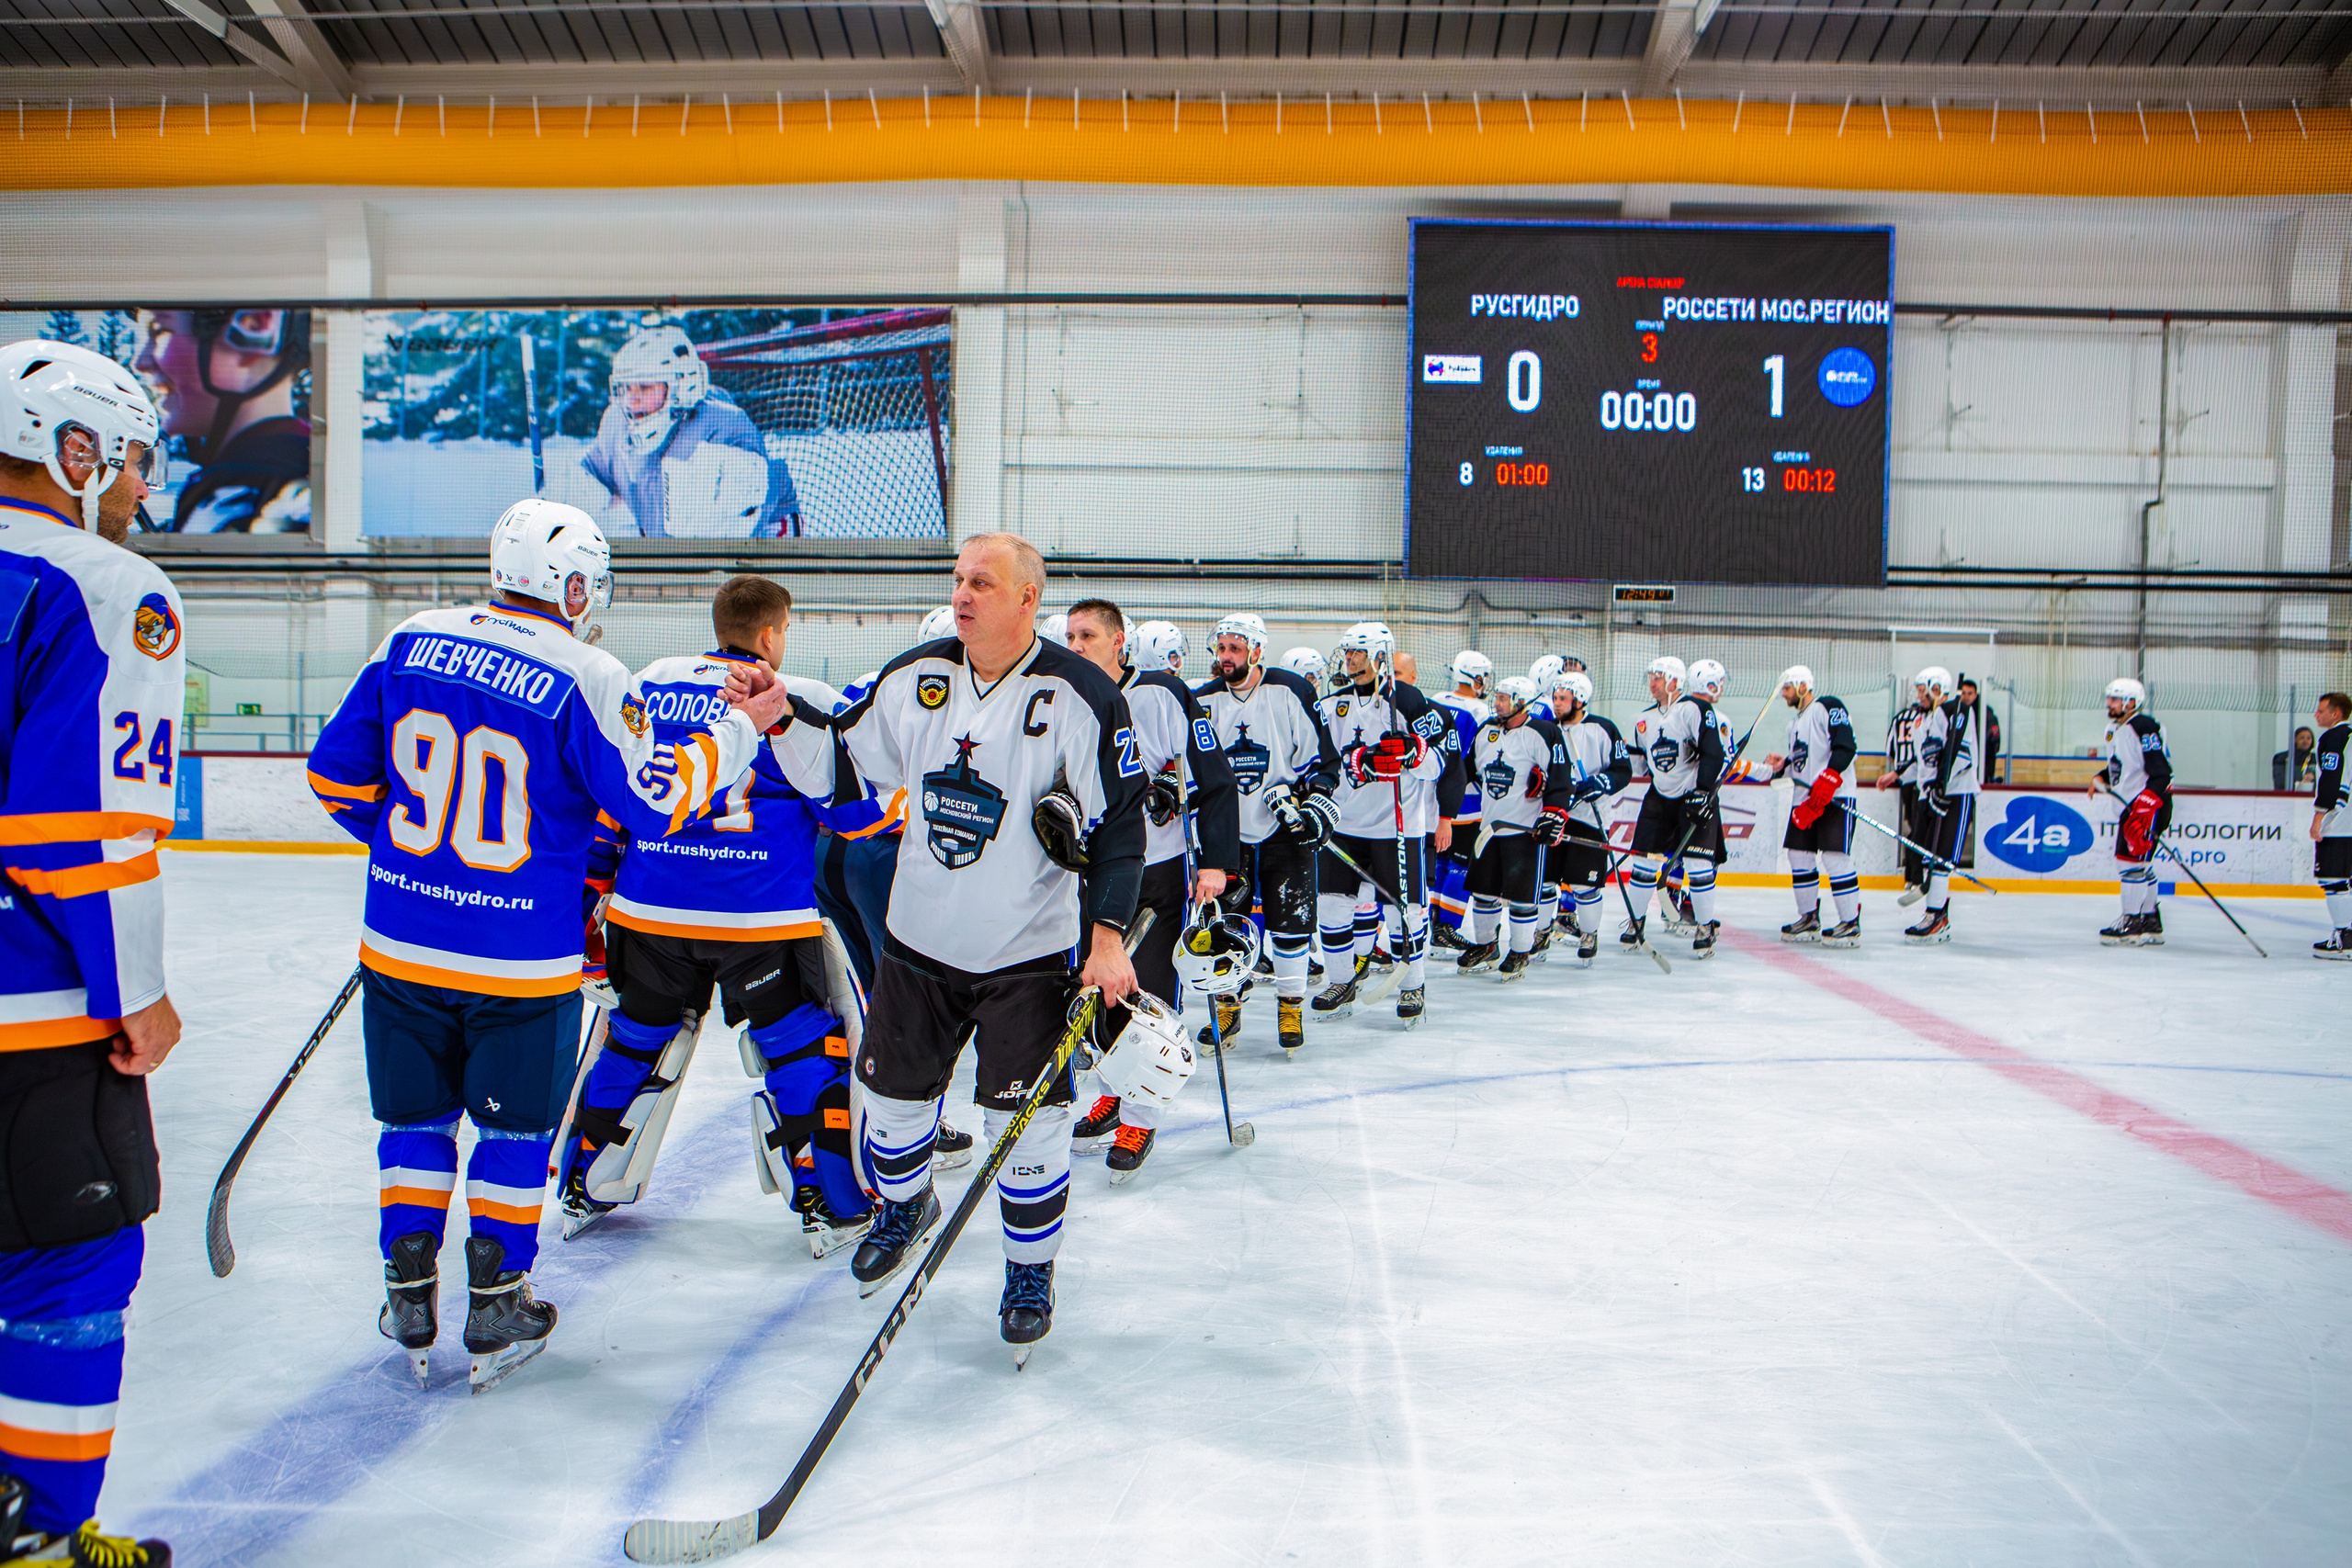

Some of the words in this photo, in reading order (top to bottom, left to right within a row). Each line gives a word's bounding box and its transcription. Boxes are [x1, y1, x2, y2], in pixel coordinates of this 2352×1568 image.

[1471, 294, 1579, 321] РУСГИДРО
[1663, 297, 1756, 321] РОССЕТИ
[1760, 299, 1890, 324] МОС.РЕГИОН
[1641, 333, 1658, 363] 3
[1508, 350, 1542, 413] 0
[1763, 355, 1784, 417] 1
[74, 386, 119, 407] BAUER
[1600, 390, 1697, 431] 00:00
[1459, 461, 1475, 487] 8
[1497, 462, 1549, 486] 01:00
[1742, 467, 1766, 493] 13
[1783, 468, 1837, 492] 00:12
[577, 546, 598, 558] BAUER
[403, 637, 556, 705] ШЕВЧЕНКО
[1023, 689, 1057, 738] C
[1411, 708, 1443, 740] 52
[113, 710, 175, 788] 24
[1114, 724, 1148, 779] 2
[1552, 742, 1566, 764] 11
[390, 708, 532, 874] 90
[941, 795, 978, 814] РОССЕТИ
[972, 814, 994, 825] РЕГИОН
[2162, 823, 2282, 841] НОЛОГИИ
[637, 839, 769, 861] sport.rushydro.ru
[370, 862, 535, 911] sport.rushydro.ru
[744, 968, 781, 992] BAUER
[994, 1089, 1032, 1100] JOF
[1011, 1079, 1050, 1139] TACKS
